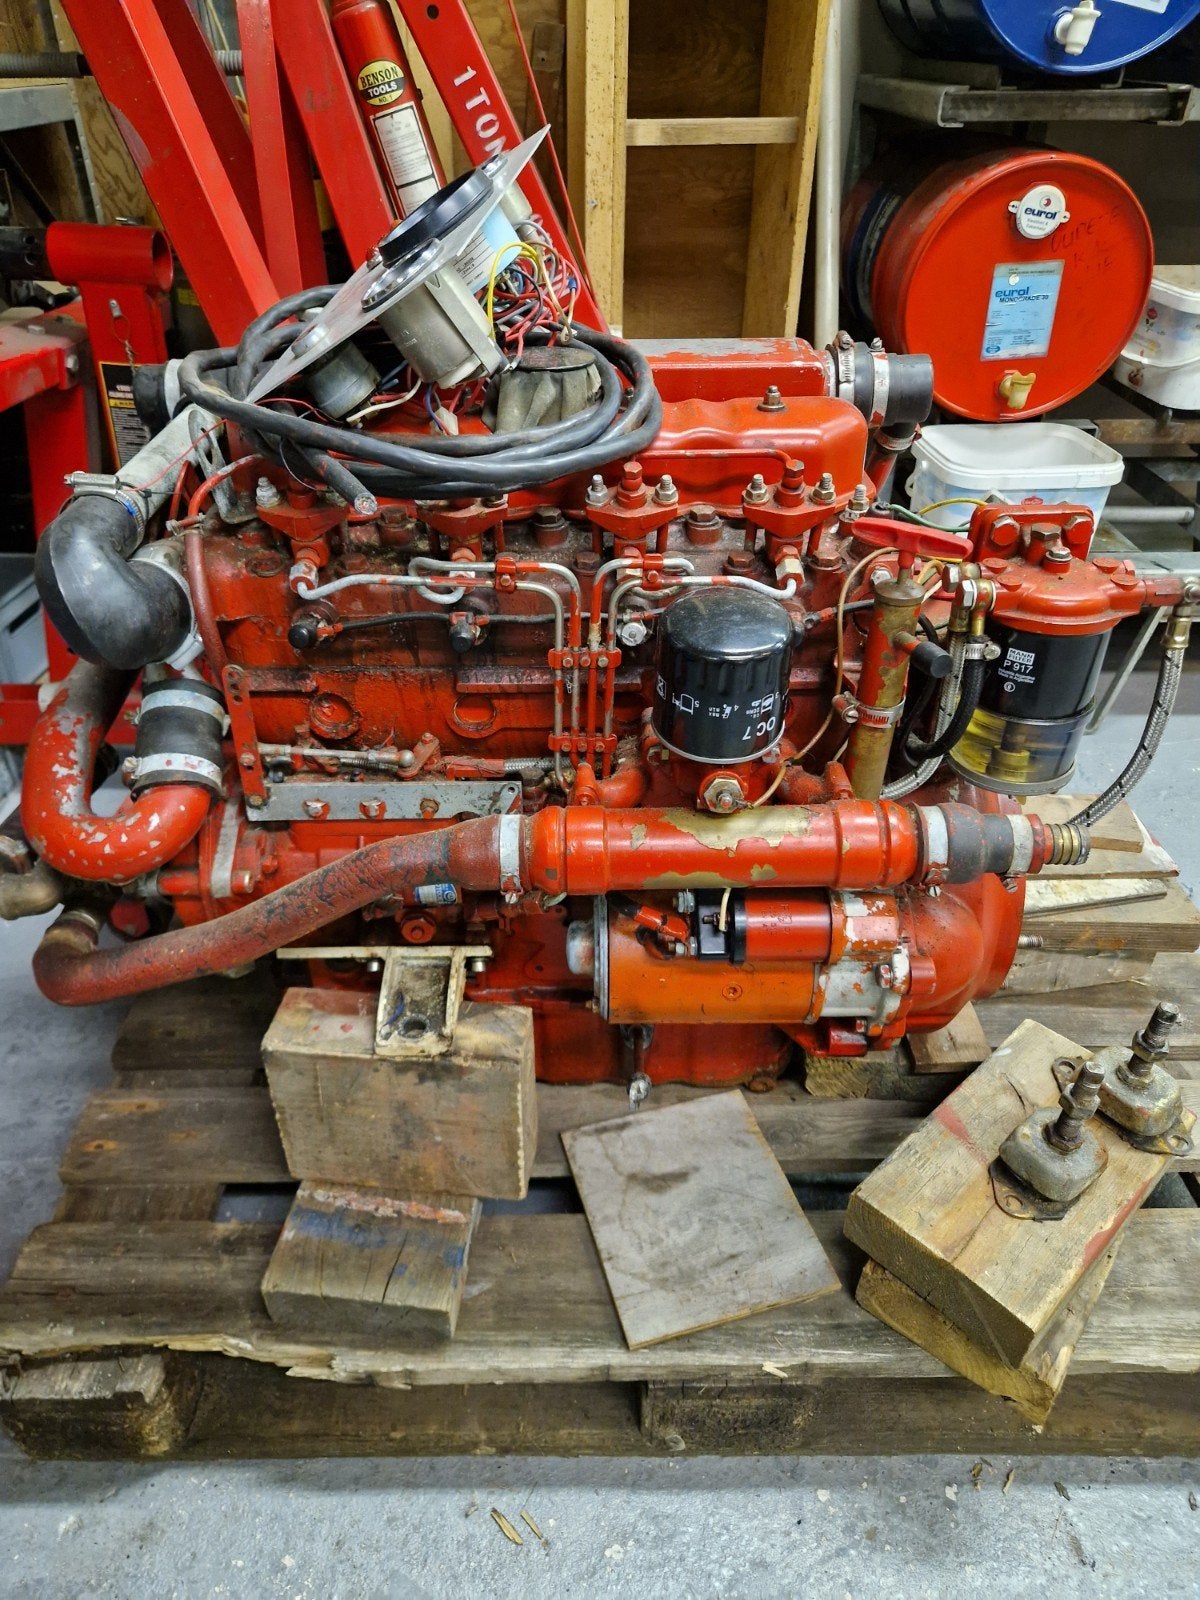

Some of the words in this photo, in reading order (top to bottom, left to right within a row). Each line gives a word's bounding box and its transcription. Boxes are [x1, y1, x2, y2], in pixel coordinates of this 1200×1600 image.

[359, 66, 399, 89] BENSON
[453, 65, 477, 87] 1
[368, 81, 398, 98] TOOLS
[1024, 207, 1058, 220] eurol
[995, 286, 1030, 298] eurol
[1008, 654, 1032, 664] FILTER
[1009, 649, 1034, 659] MANN
[1012, 662, 1034, 674] 917
[742, 726, 751, 740] 7
[756, 716, 776, 737] OC
